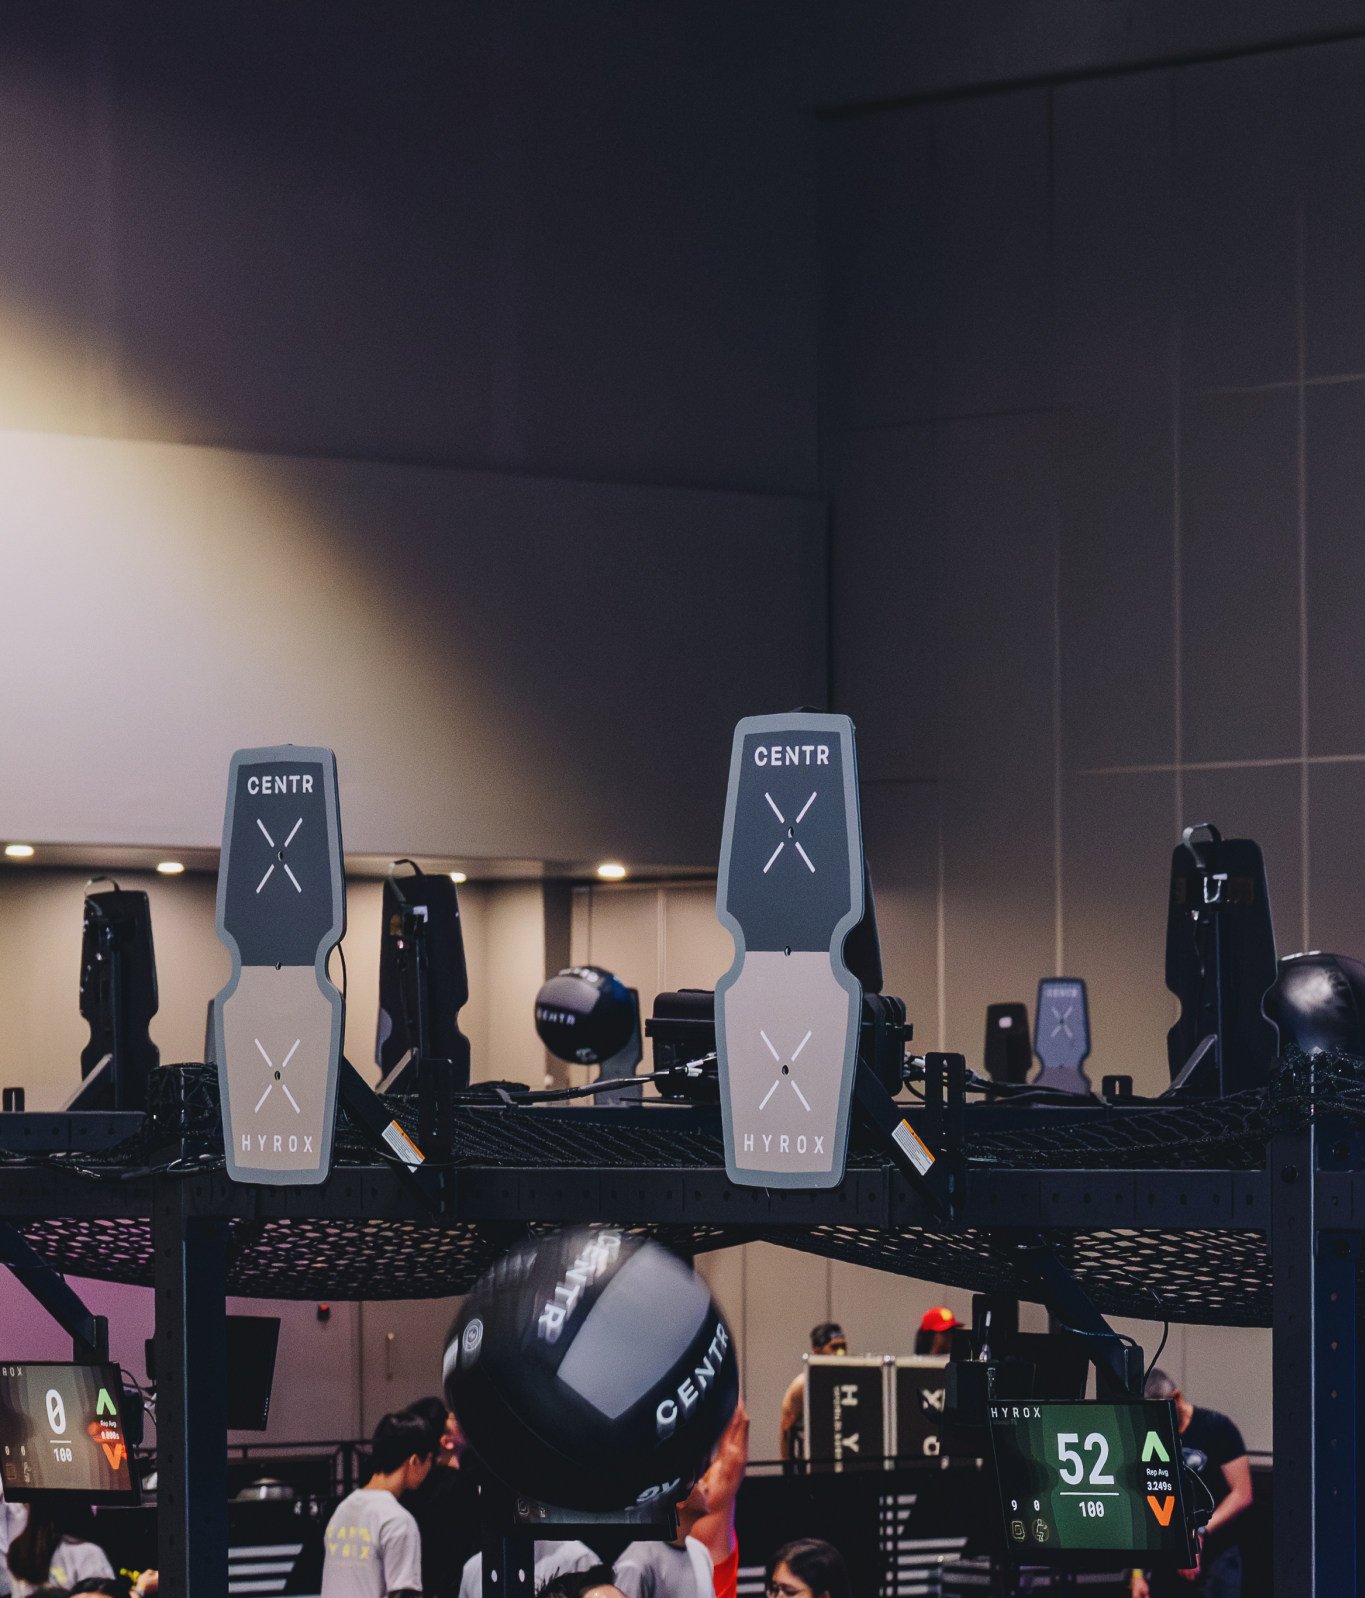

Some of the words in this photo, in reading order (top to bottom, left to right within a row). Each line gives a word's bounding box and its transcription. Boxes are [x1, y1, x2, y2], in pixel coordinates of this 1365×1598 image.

[754, 745, 829, 766] CENTR
[247, 774, 313, 795] CENTR
[242, 1134, 313, 1153] HYROX
[744, 1134, 824, 1154] HYROX
[2, 1367, 22, 1377] ROX
[656, 1323, 728, 1424] CENTR
[46, 1389, 66, 1435] 0
[991, 1407, 1040, 1418] HYROX
[54, 1447, 72, 1462] 100
[1057, 1433, 1115, 1485] 52
[1146, 1468, 1157, 1477] Rep
[1158, 1469, 1169, 1478] Avg
[1147, 1481, 1172, 1491] 3.249s
[1012, 1500, 1018, 1511] 9
[1034, 1500, 1040, 1511] 0
[1079, 1501, 1105, 1518] 100
